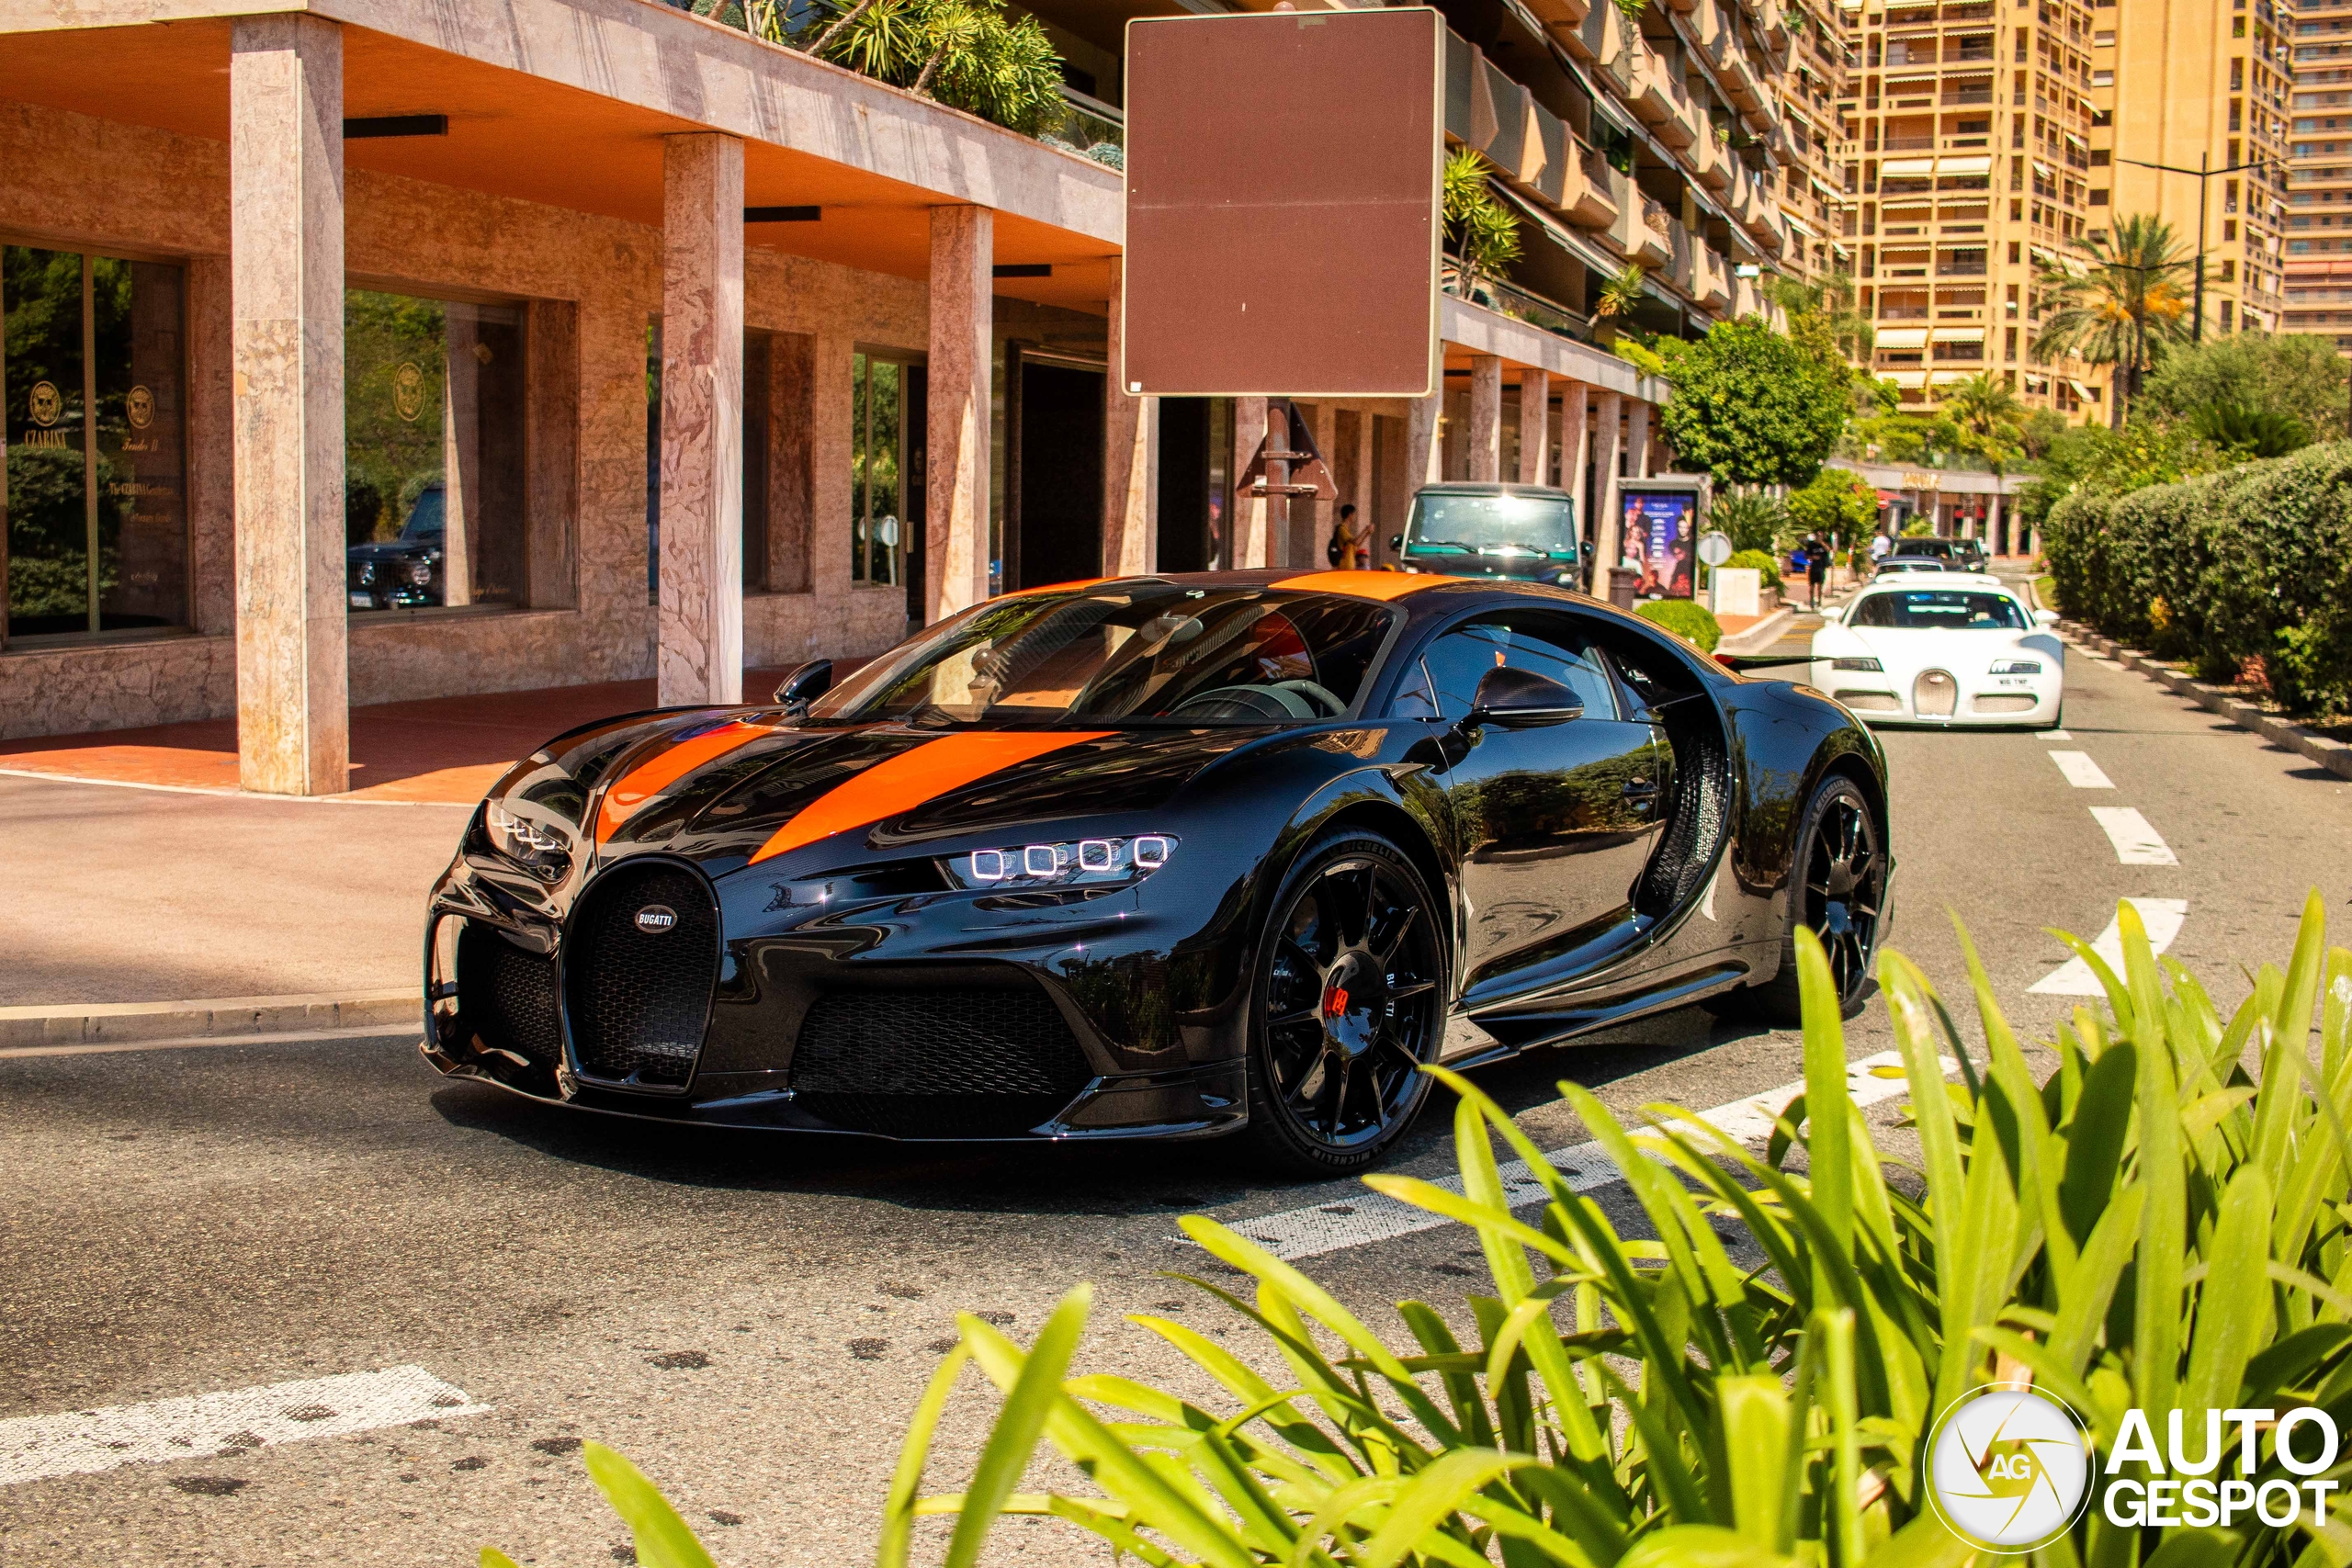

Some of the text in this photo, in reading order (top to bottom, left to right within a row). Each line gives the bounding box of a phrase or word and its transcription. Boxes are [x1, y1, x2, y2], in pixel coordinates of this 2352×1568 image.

[24, 429, 67, 449] CZARINA
[1341, 840, 1399, 863] MICHELIN
[639, 913, 673, 926] BUGATTI
[1312, 1147, 1371, 1166] MICHELIN
